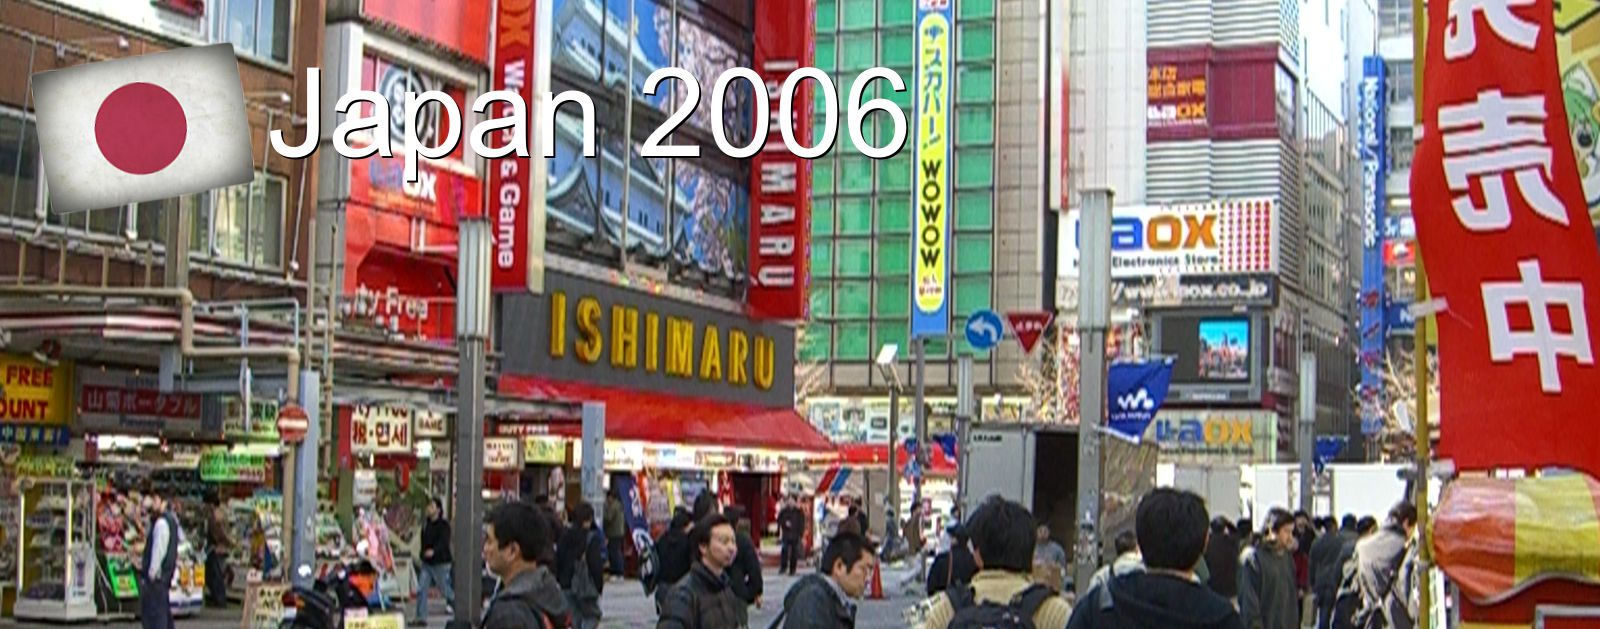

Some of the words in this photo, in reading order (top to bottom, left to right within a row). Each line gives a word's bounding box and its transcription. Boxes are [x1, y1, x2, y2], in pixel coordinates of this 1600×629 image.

[497, 184, 521, 269] Game
[920, 159, 942, 269] WOWOW
[1075, 214, 1218, 251] aox
[1112, 255, 1179, 268] Electronics
[1184, 253, 1219, 266] Store
[551, 291, 775, 391] ISHIMARU
[5, 364, 54, 387] FREE
